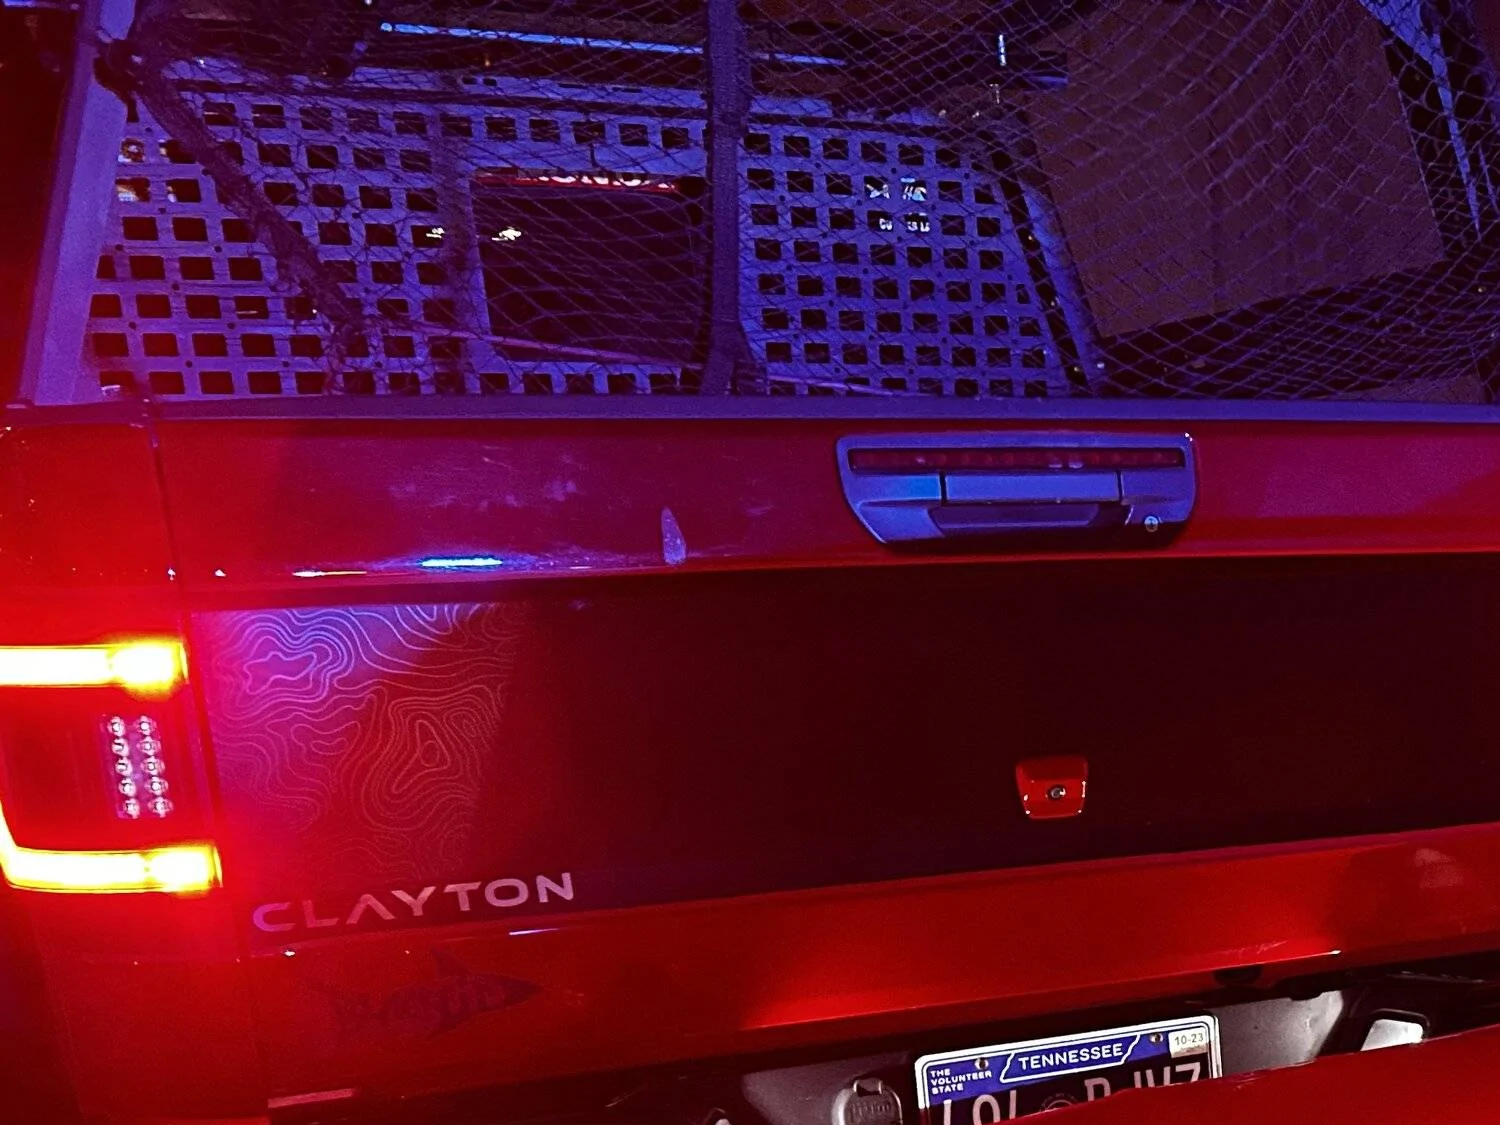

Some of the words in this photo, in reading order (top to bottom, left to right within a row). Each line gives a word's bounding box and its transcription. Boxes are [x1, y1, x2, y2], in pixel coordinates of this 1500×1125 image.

[252, 872, 575, 932] CLAYTON
[1018, 1043, 1123, 1070] TENNESSEE
[930, 1068, 951, 1078] THE
[930, 1070, 992, 1087] VOLUNTEER
[931, 1082, 964, 1095] STATE
